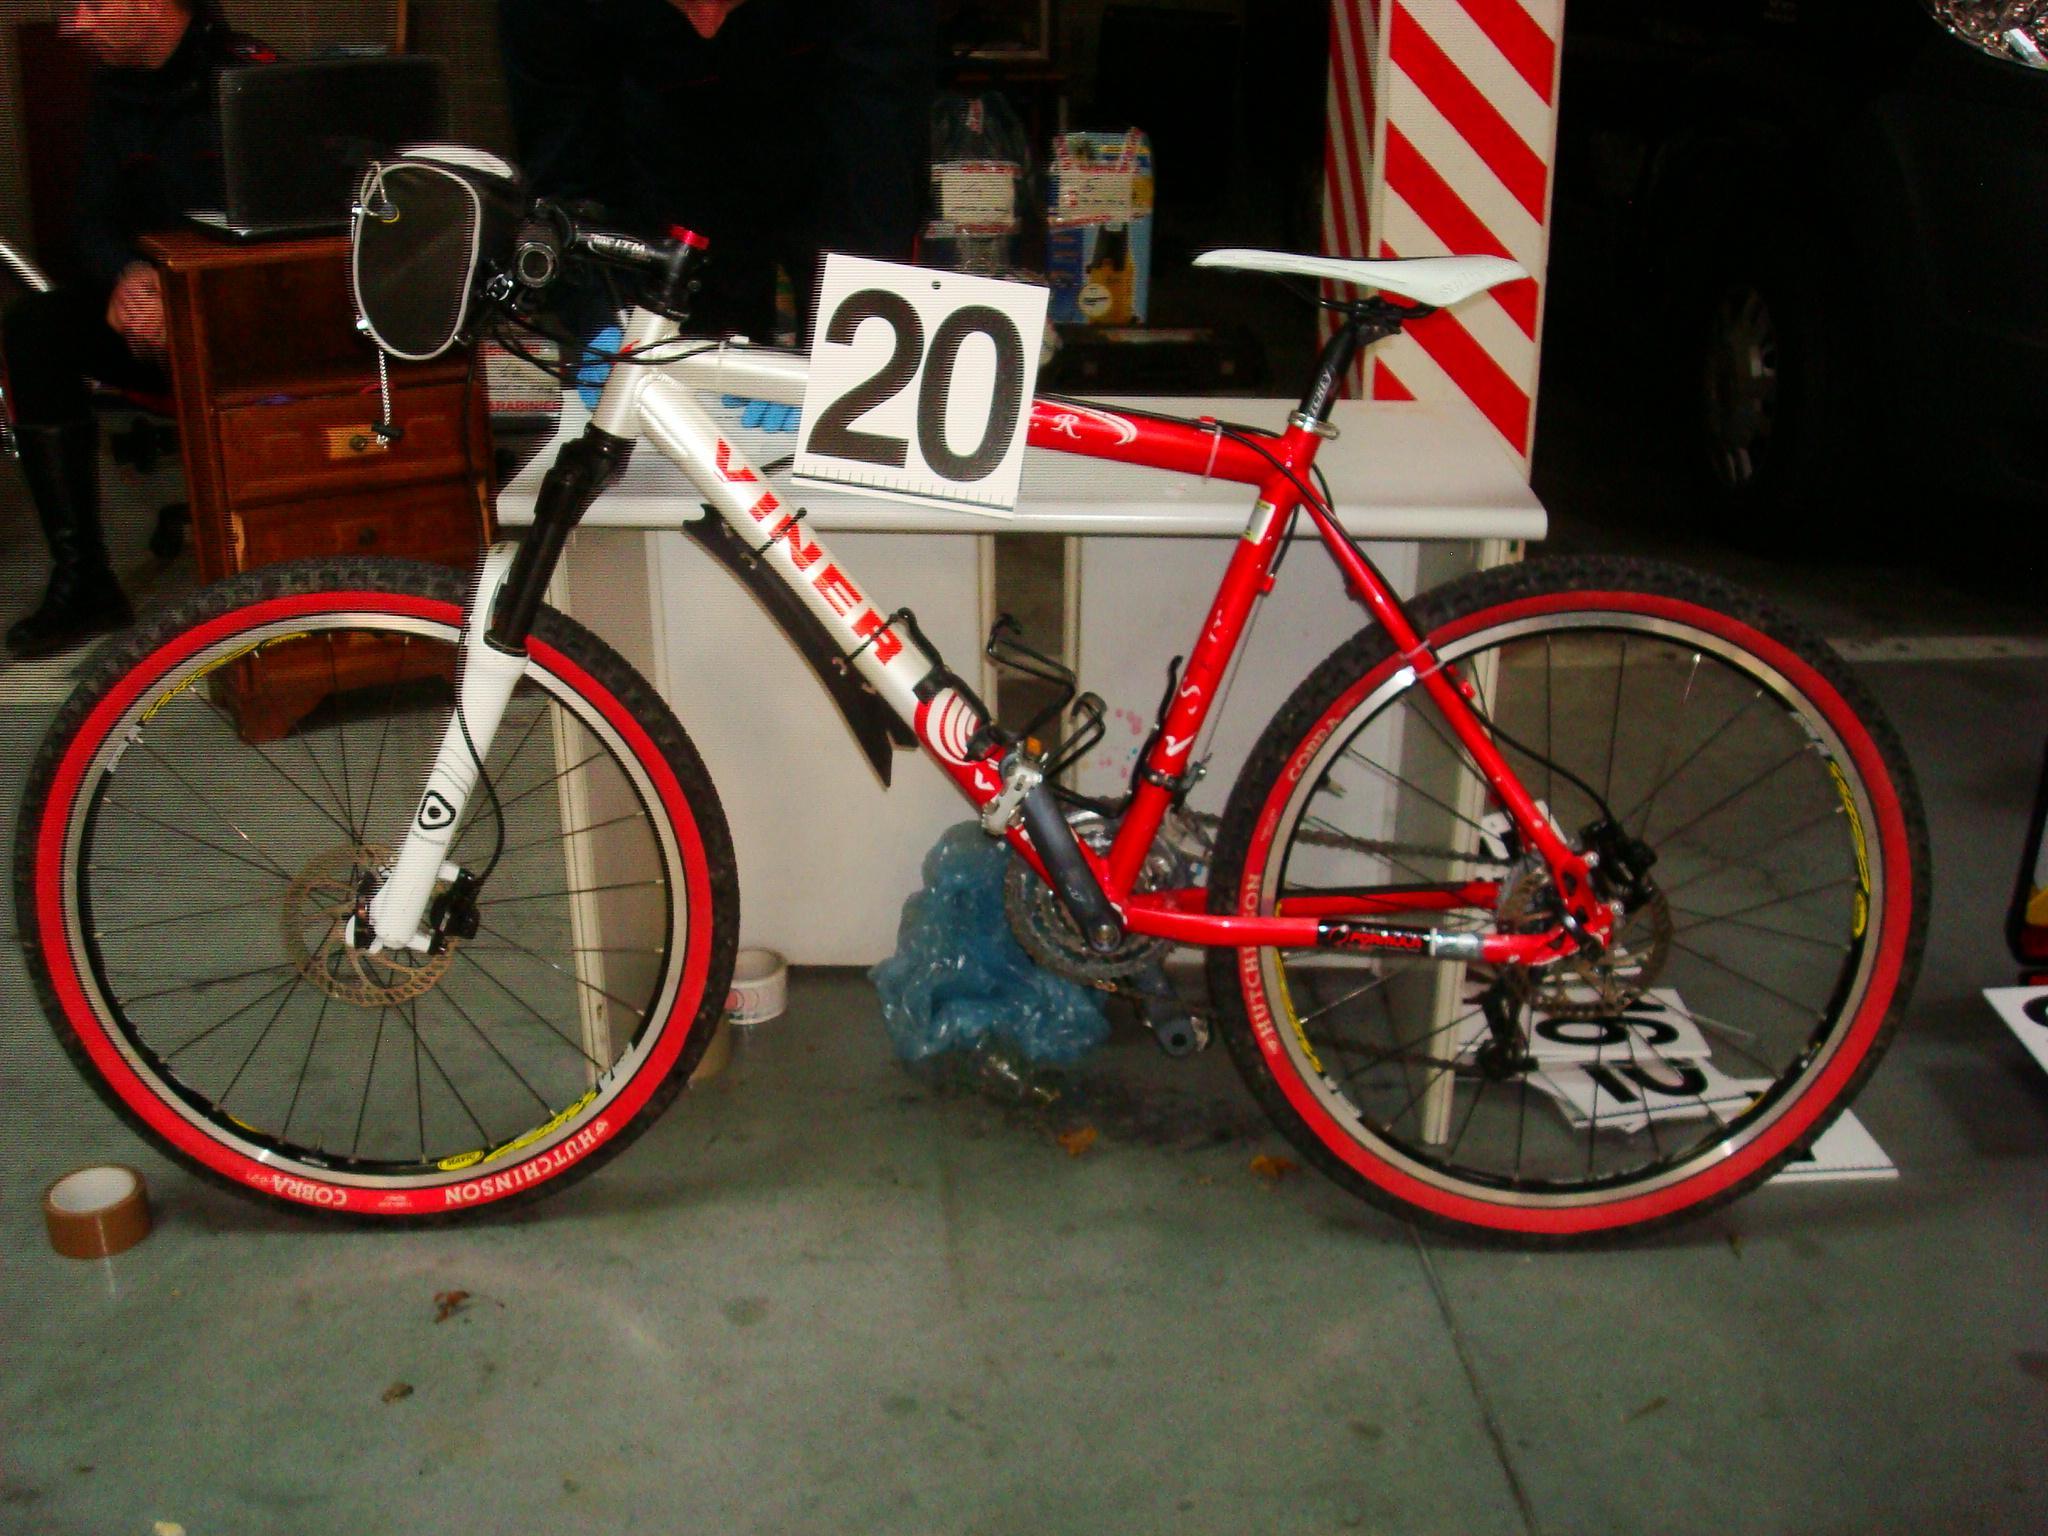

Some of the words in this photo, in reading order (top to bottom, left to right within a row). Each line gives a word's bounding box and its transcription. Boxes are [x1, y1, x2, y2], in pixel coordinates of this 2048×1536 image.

[806, 288, 1024, 482] 20
[715, 438, 903, 666] VINER
[1288, 718, 1340, 782] COBRA
[272, 1174, 348, 1206] COBRA
[445, 1129, 597, 1205] HUTCHINSON
